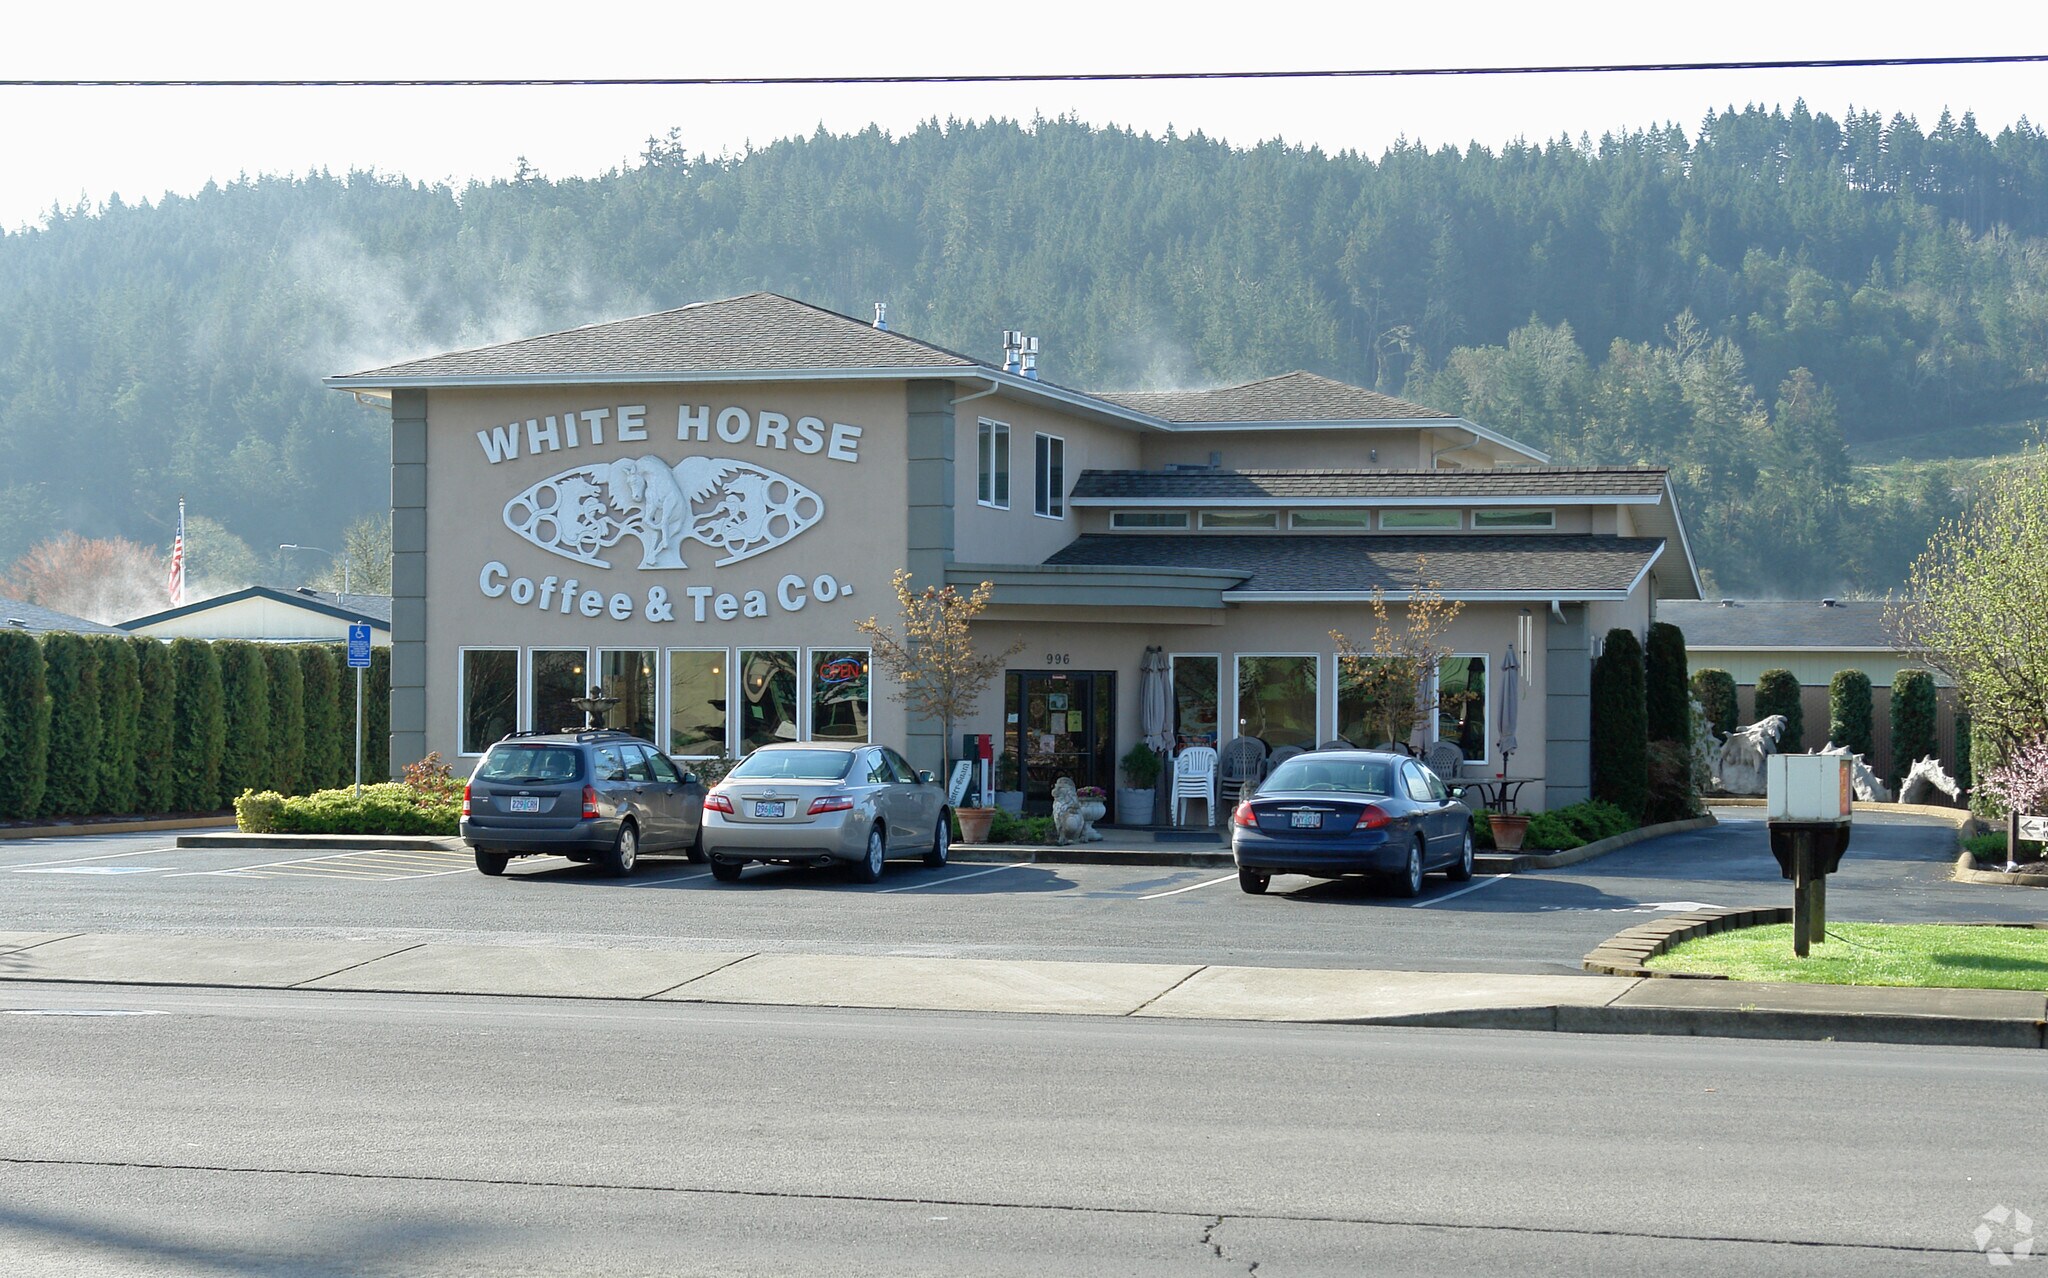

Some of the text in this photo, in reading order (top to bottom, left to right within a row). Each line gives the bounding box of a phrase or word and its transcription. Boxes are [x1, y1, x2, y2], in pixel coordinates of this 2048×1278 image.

[476, 404, 863, 464] WHITE HORSE
[479, 561, 854, 623] Coffee & Tea Co.
[819, 663, 860, 679] OPEN
[1046, 653, 1070, 665] 996
